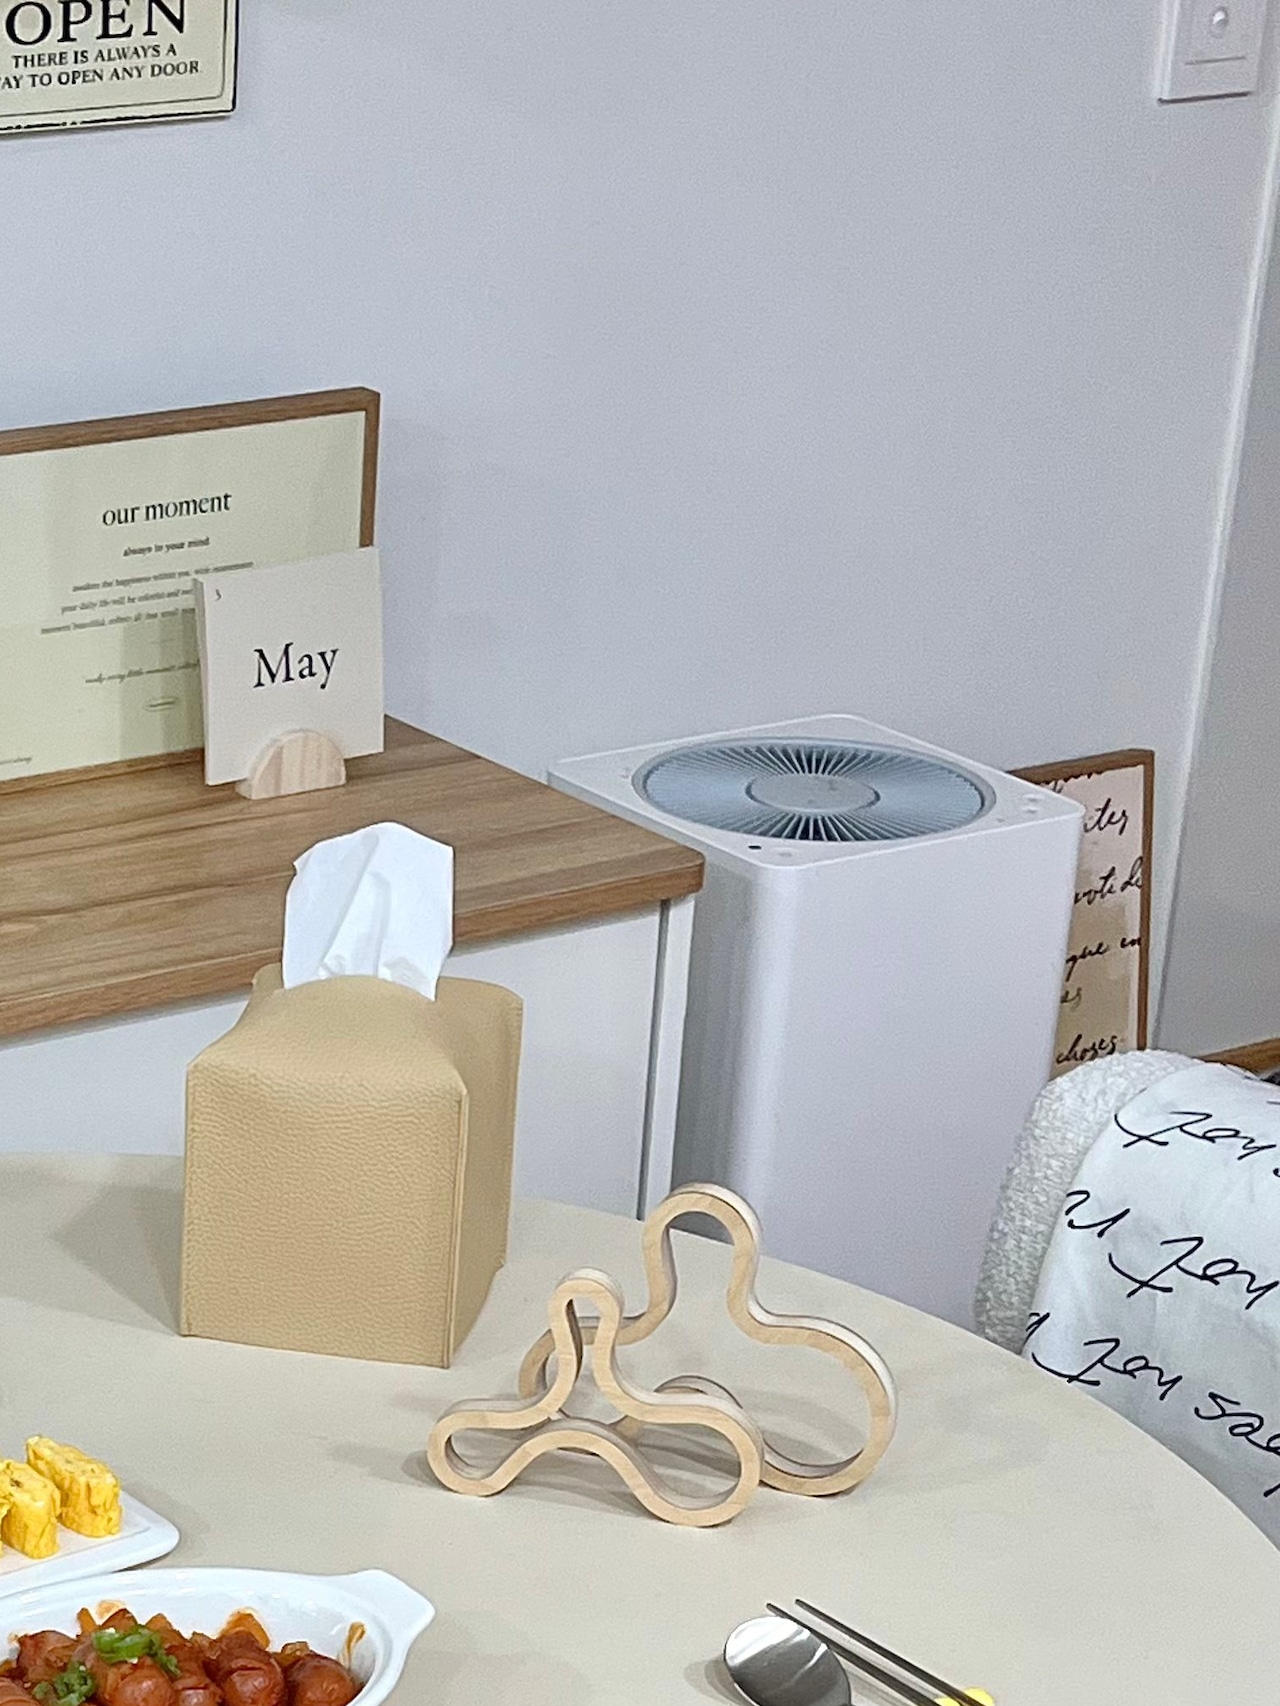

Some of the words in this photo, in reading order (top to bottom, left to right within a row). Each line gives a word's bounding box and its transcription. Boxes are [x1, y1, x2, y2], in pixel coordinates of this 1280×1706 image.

[5, 0, 186, 45] OPEN
[12, 53, 68, 69] THERE
[73, 51, 89, 64] IS
[95, 45, 160, 62] ALWAYS
[165, 43, 177, 57] A
[29, 73, 52, 87] TO
[57, 69, 104, 85] OPEN
[109, 66, 144, 81] ANY
[150, 60, 200, 77] DOOR
[103, 506, 140, 526] our
[144, 493, 232, 521] moment
[252, 642, 340, 690] May
